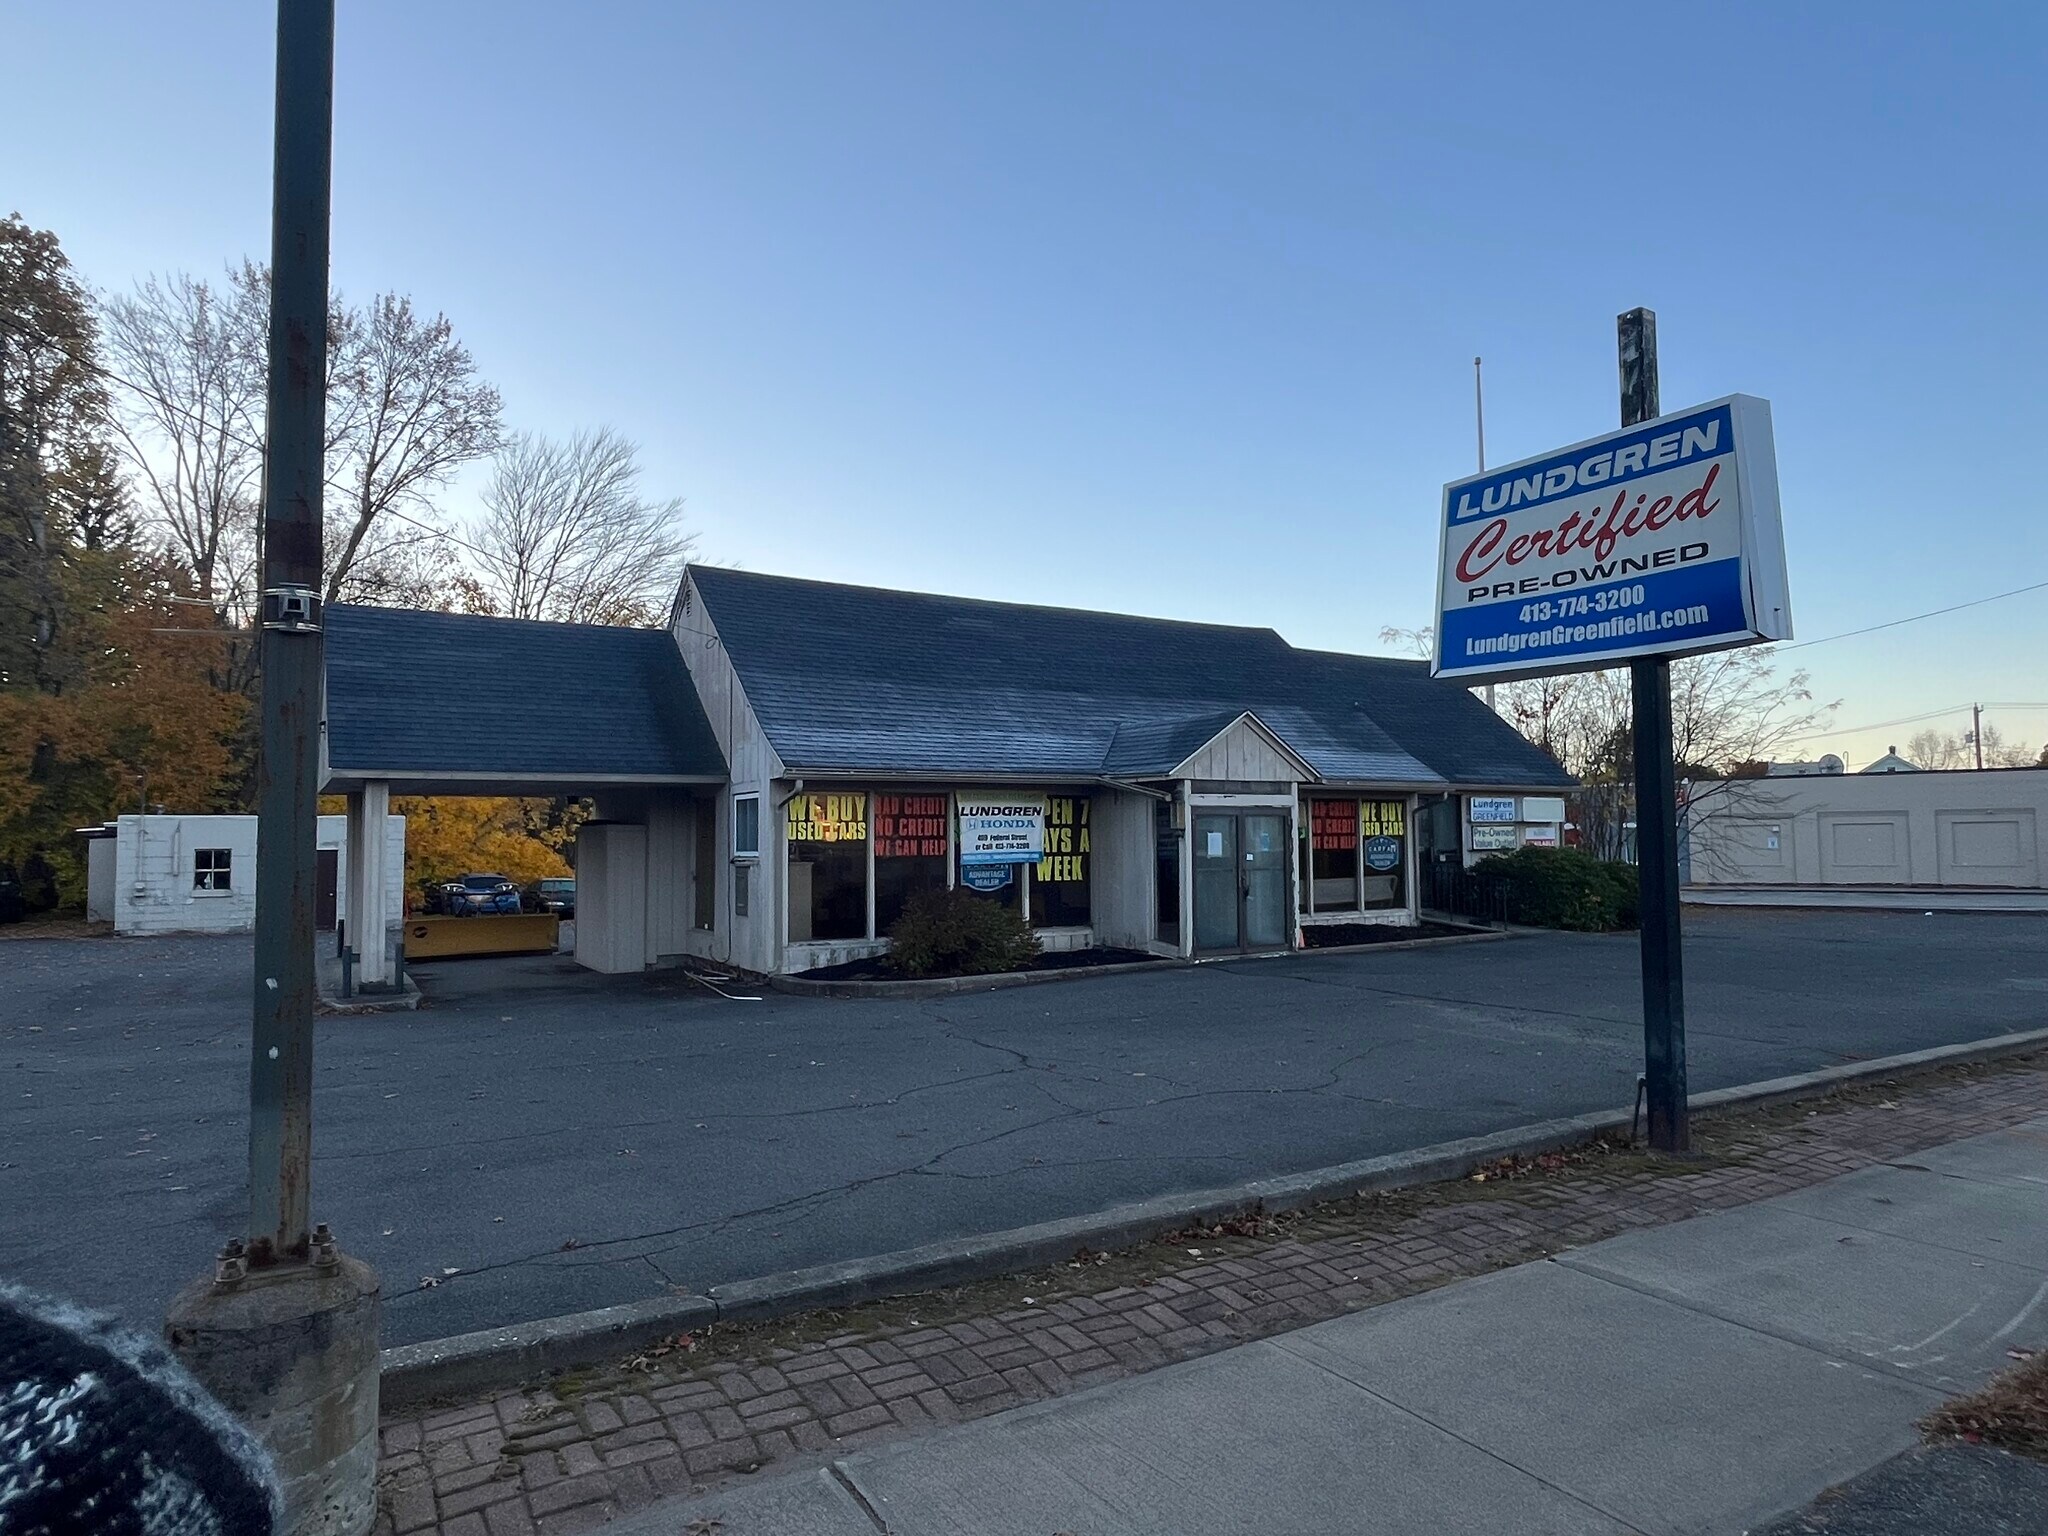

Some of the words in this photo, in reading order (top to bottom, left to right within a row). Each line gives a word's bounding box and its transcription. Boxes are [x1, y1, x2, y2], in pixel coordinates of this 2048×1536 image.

[1456, 419, 1720, 520] LUNDGREN
[1456, 463, 1720, 583] Certified
[1467, 542, 1709, 602] PRE-OWNED
[1519, 584, 1645, 624] 413-774-3200
[1466, 604, 1709, 656] LundgrenGreenfield.com
[789, 795, 817, 821] WE
[826, 795, 866, 822] BUY
[903, 796, 946, 815] CREDIT
[960, 806, 1043, 817] LUNDGREN
[1044, 798, 1073, 825] PEN
[1081, 799, 1090, 825] 7
[1380, 802, 1403, 822] BUY
[1473, 798, 1513, 811] Lundgren
[980, 819, 1036, 829] HONDA
[1325, 818, 1356, 834] CREDIT
[1472, 812, 1514, 821] GREENFIELD
[788, 821, 824, 841] USED
[825, 821, 866, 842] CARS
[875, 817, 894, 837] NO
[898, 818, 946, 837] CREDIT
[1382, 821, 1404, 836] CARS
[1473, 828, 1516, 838] Pre-Owned
[875, 839, 891, 856] WE
[895, 839, 918, 856] CAN
[921, 839, 947, 856] HELP
[1044, 827, 1072, 853] AYS
[1080, 827, 1090, 853] A
[1474, 839, 1494, 848] Value
[1036, 855, 1083, 882] WEEK
[974, 879, 1000, 887] DEALER
